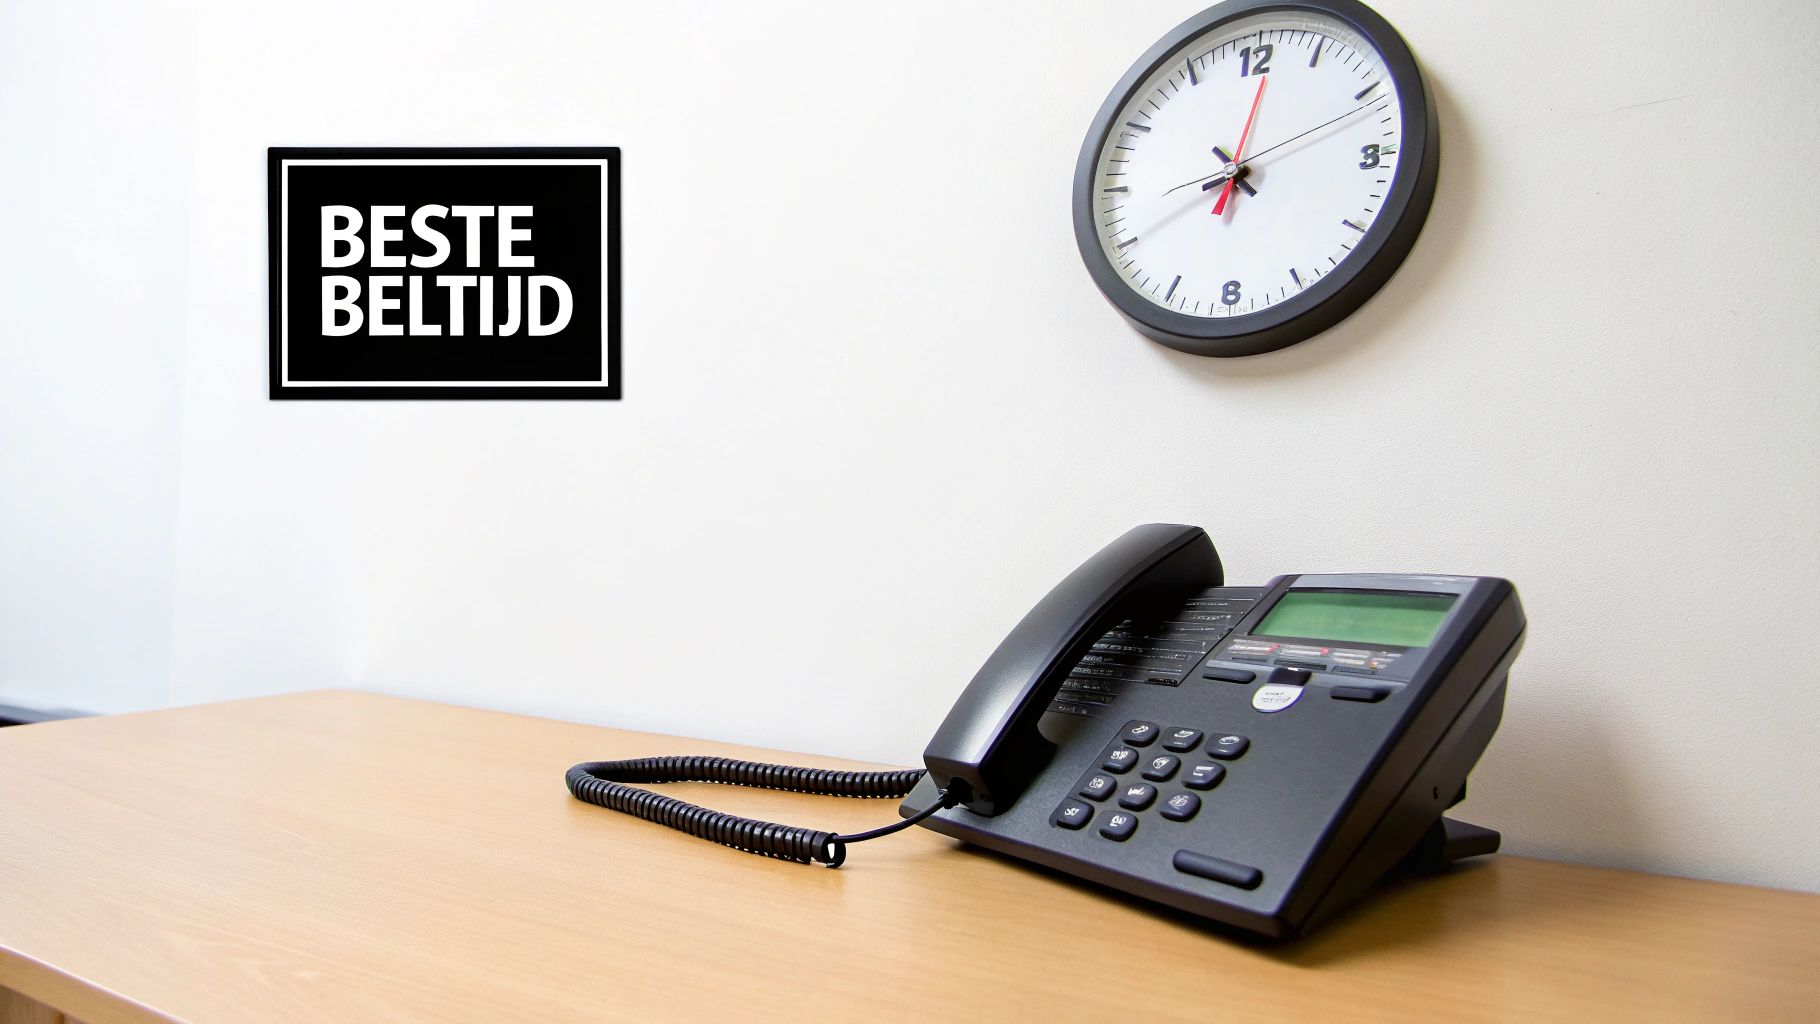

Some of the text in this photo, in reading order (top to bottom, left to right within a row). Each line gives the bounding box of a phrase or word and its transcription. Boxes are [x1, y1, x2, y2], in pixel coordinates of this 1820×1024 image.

[1239, 44, 1274, 77] 12
[321, 203, 535, 269] BESTE
[321, 275, 574, 337] BELTIJD
